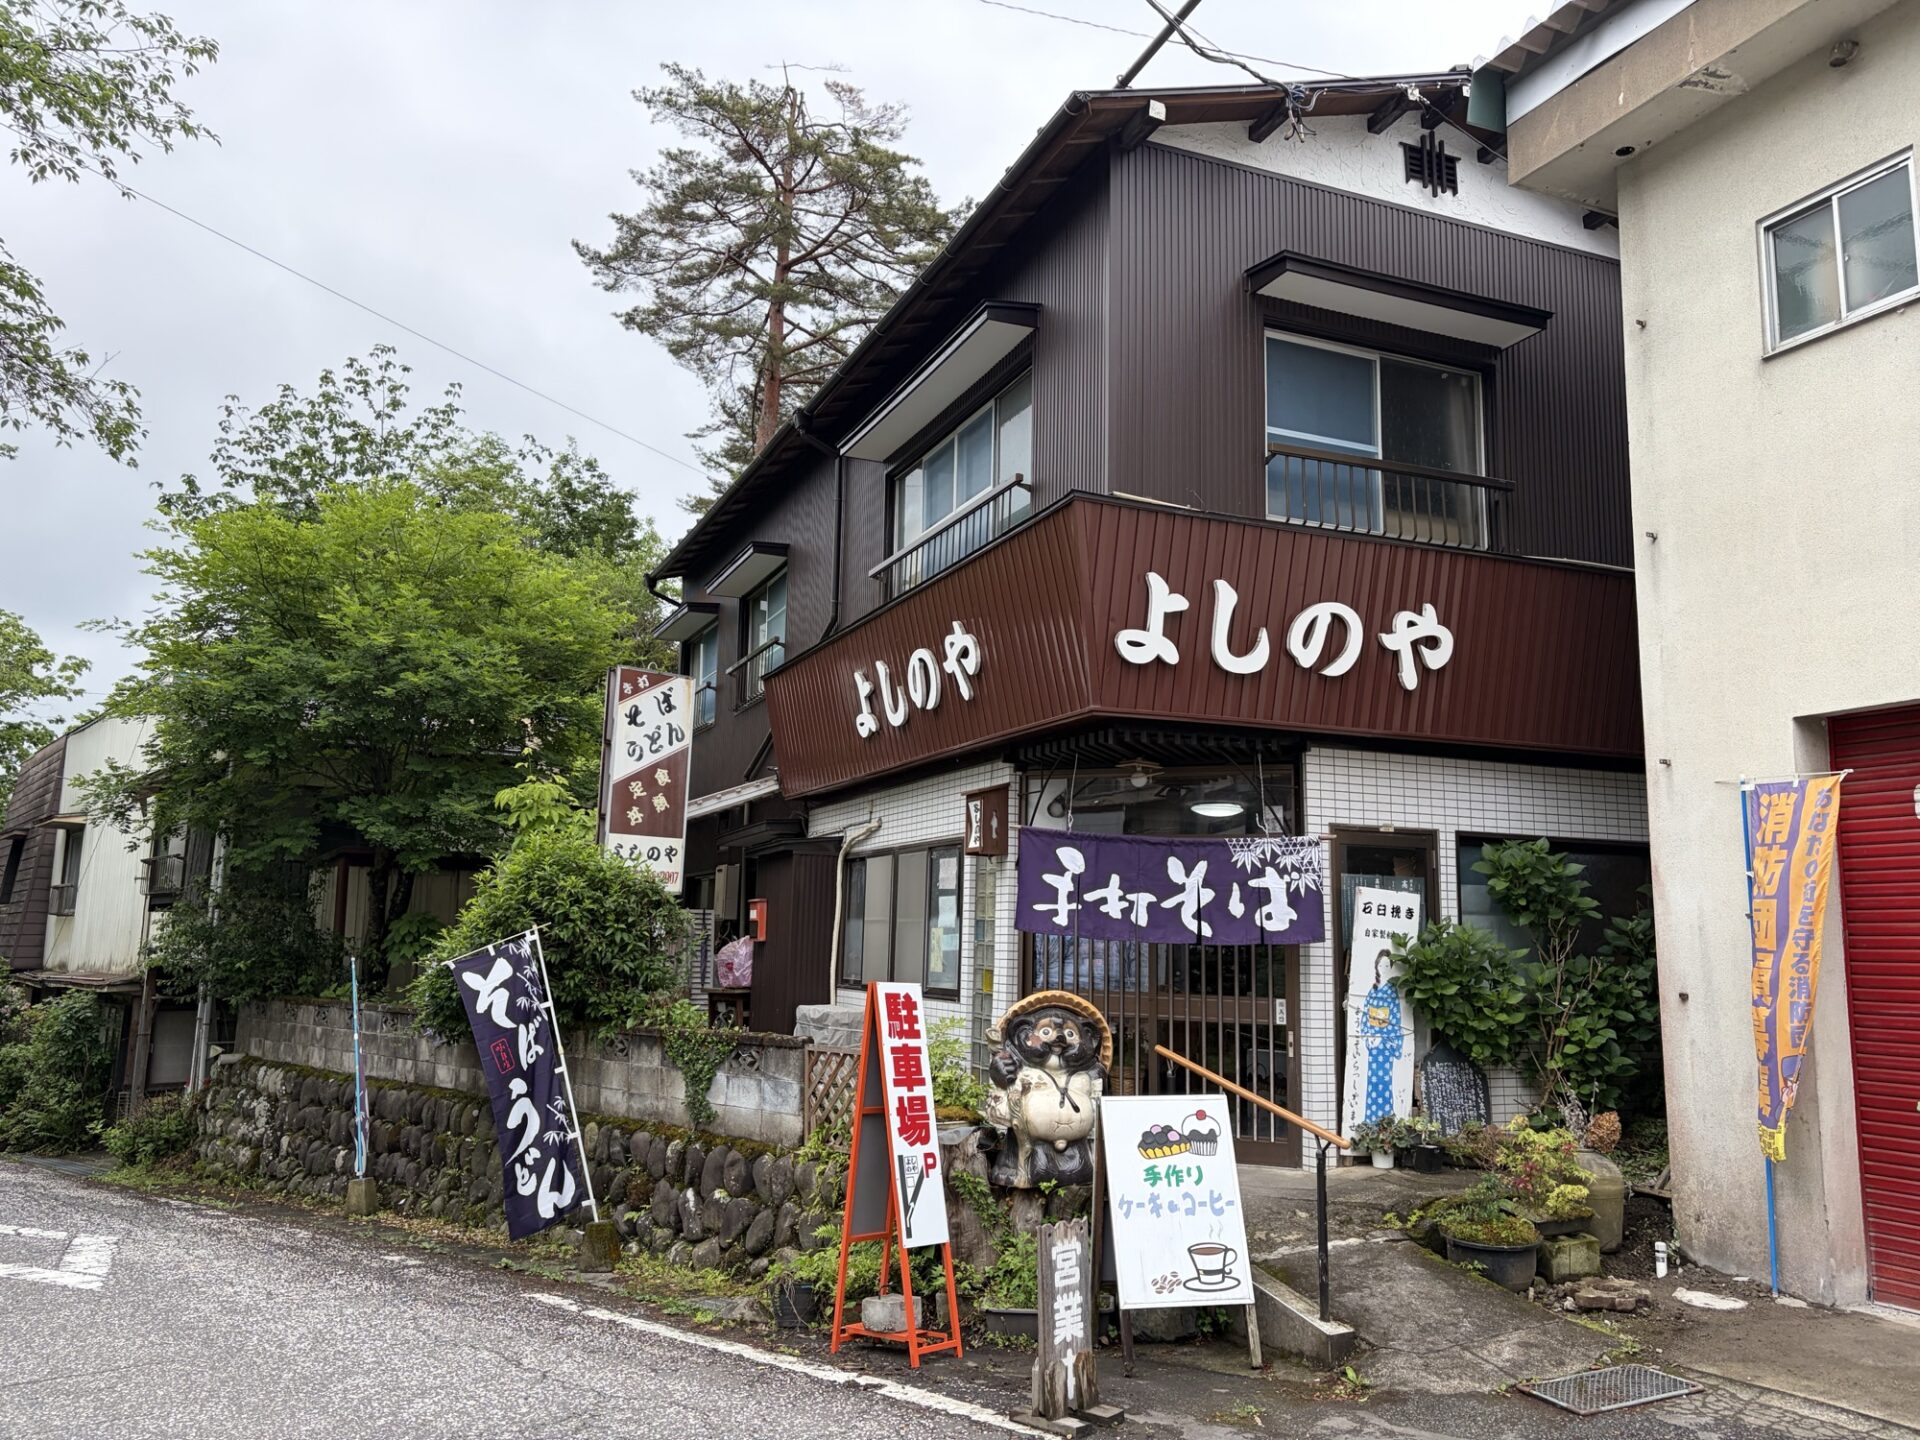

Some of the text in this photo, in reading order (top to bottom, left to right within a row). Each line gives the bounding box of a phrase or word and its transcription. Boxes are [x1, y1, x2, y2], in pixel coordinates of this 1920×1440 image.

[1114, 572, 1454, 691] よしのや
[624, 686, 677, 728] そば
[853, 620, 982, 738] よしのや
[626, 722, 686, 762] うどん
[1032, 846, 1299, 938] 手打そば
[884, 991, 932, 1148] 駐車場
[923, 1151, 937, 1178] P
[1143, 1164, 1204, 1188] 手作り
